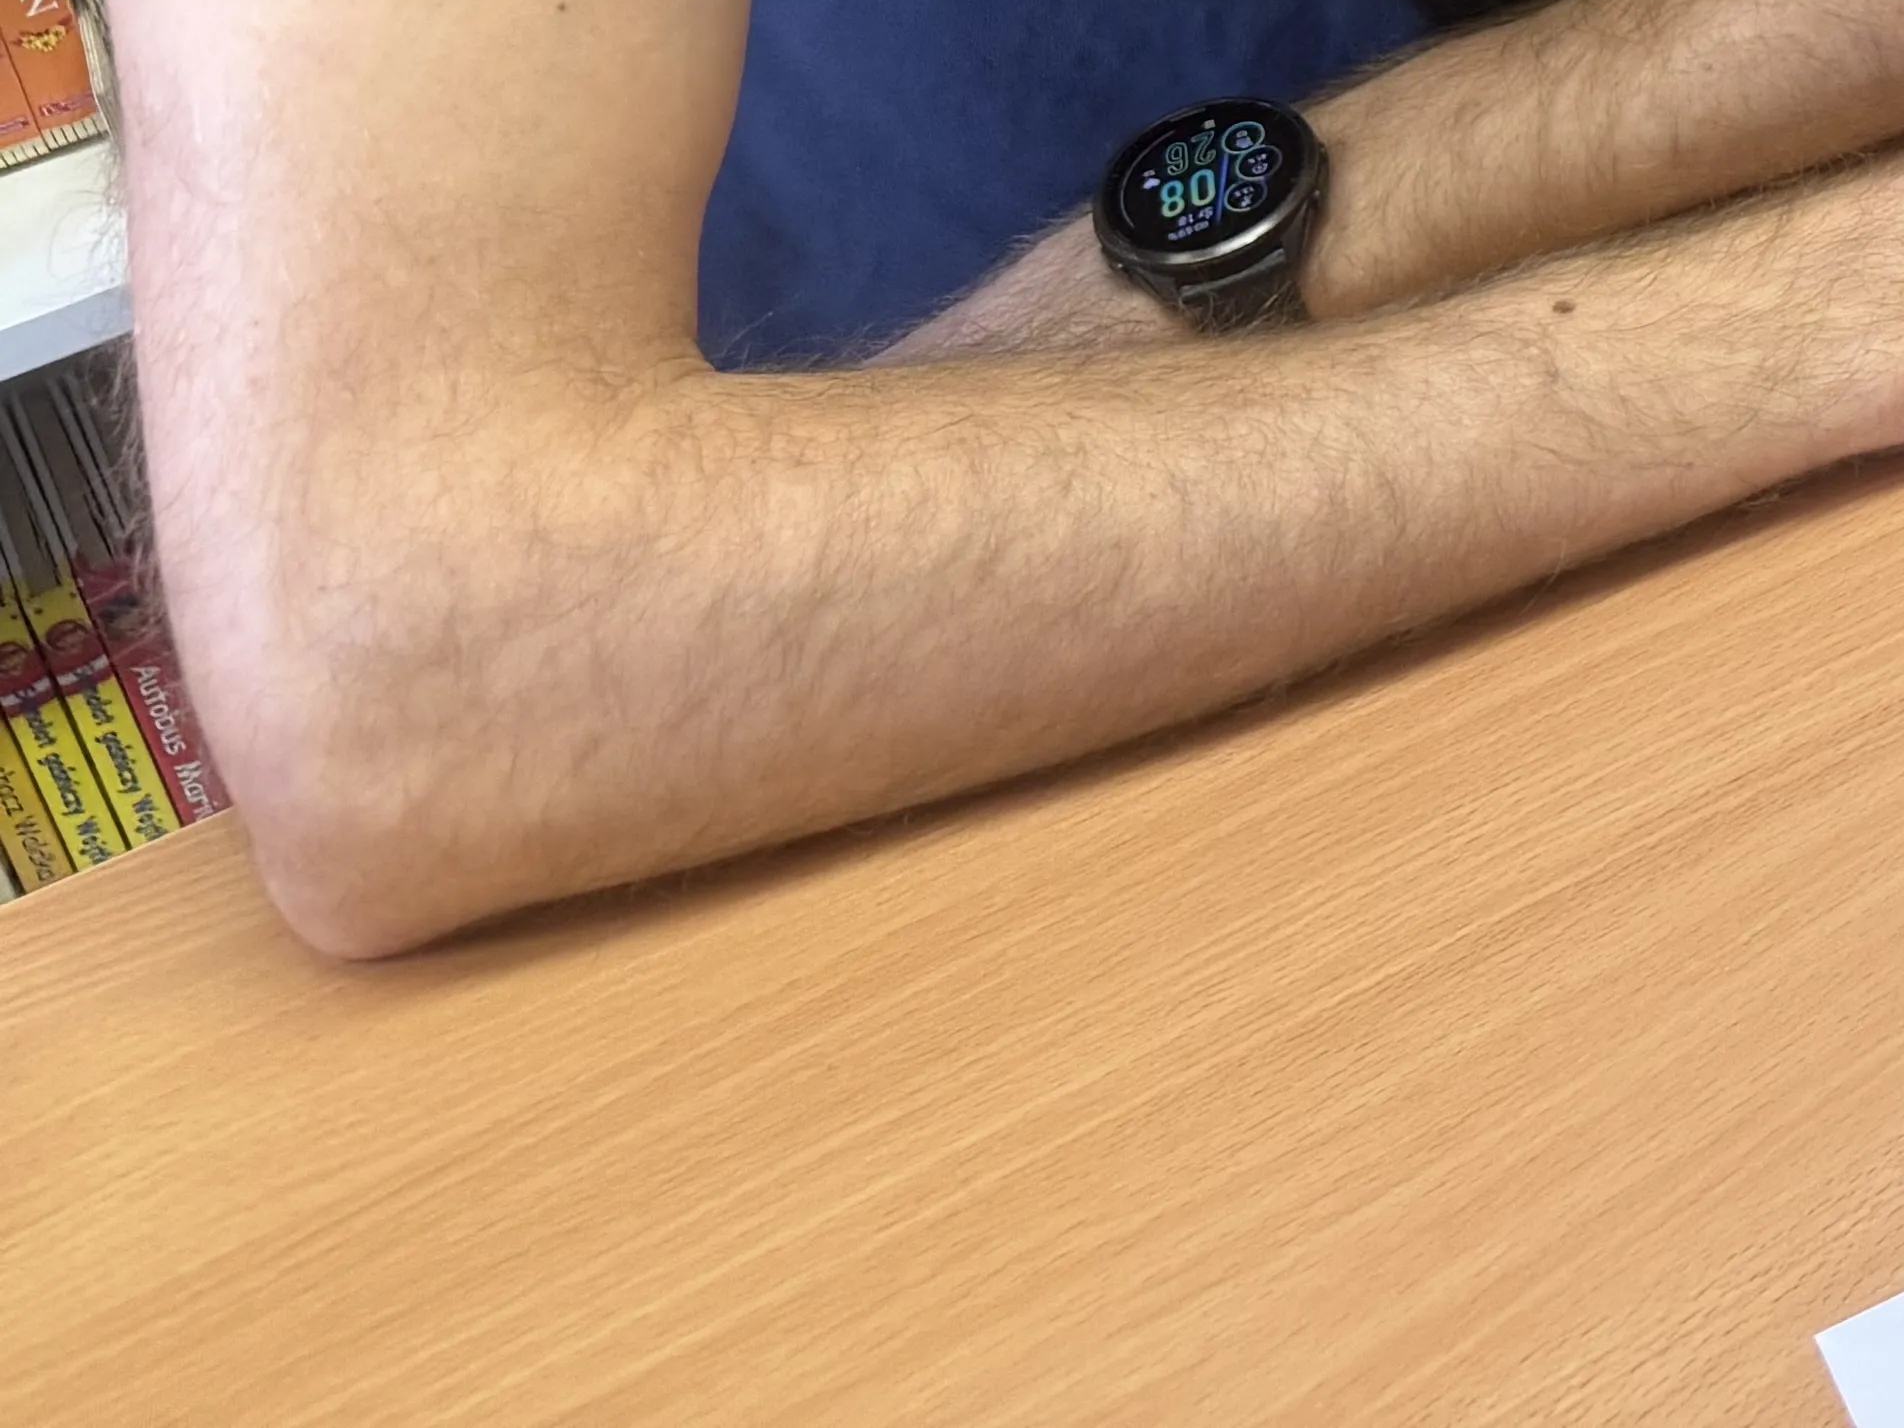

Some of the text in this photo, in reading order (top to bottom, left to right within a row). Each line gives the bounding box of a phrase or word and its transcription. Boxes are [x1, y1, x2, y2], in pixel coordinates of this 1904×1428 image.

[1164, 131, 1217, 176] 26
[1160, 168, 1217, 218] 08
[131, 662, 187, 758] Autobus
